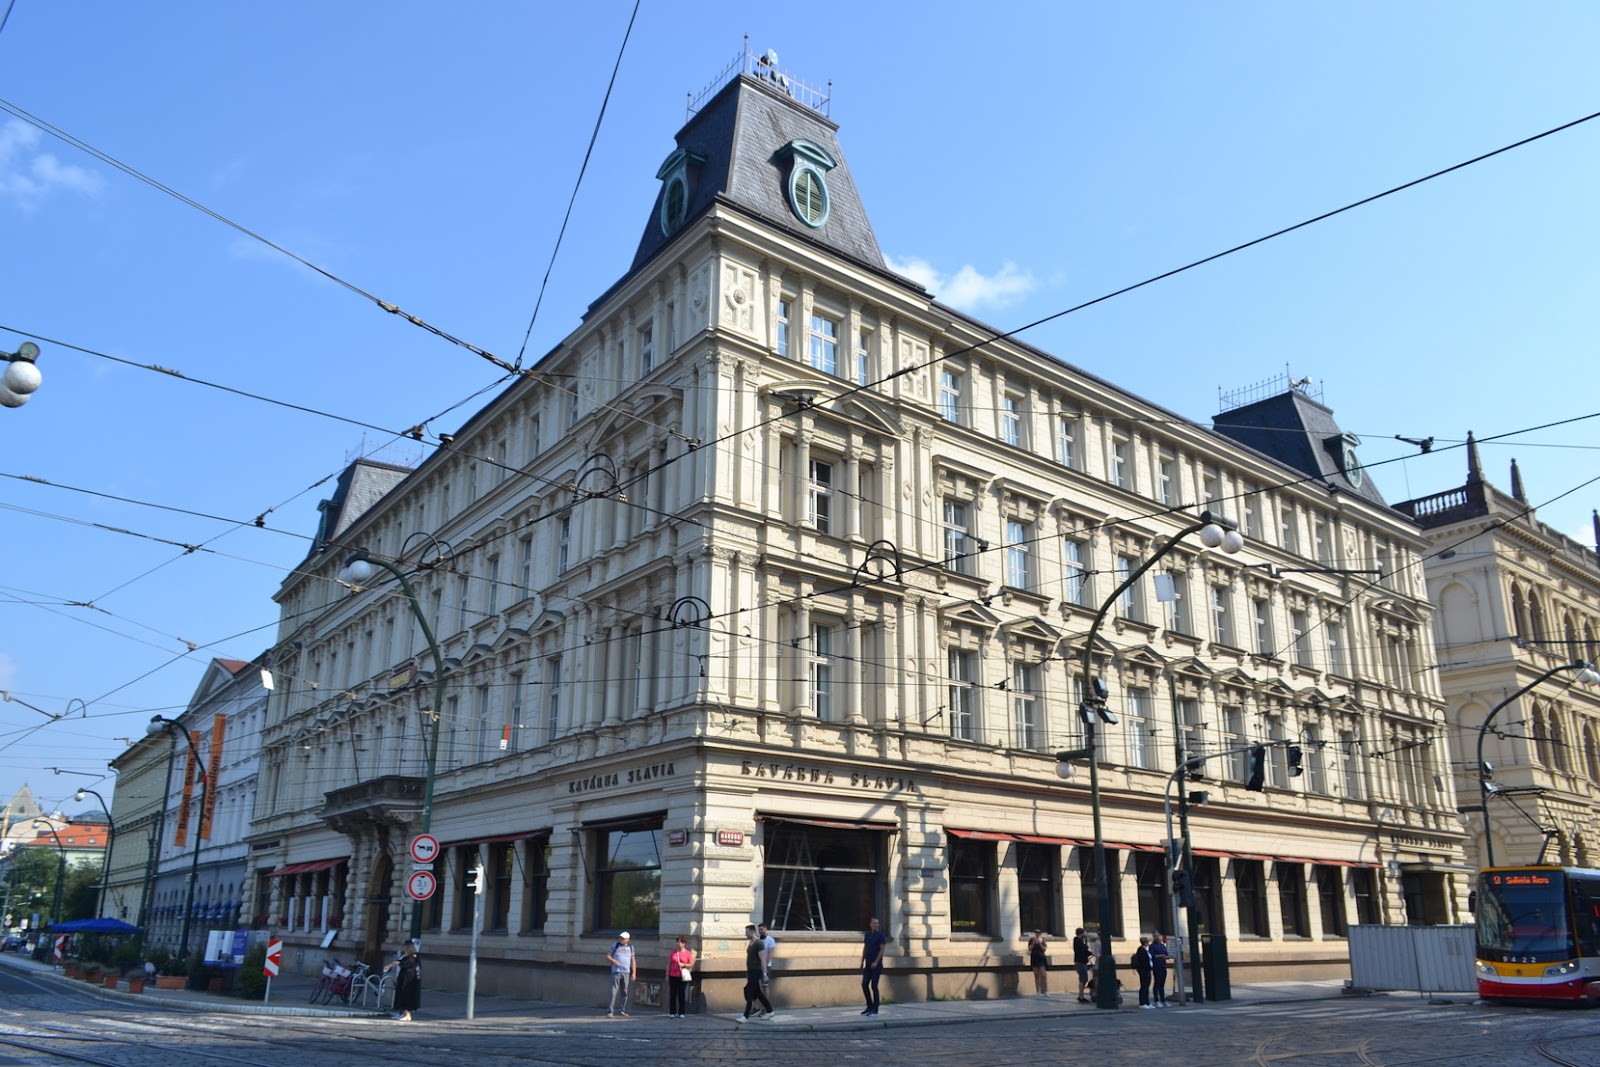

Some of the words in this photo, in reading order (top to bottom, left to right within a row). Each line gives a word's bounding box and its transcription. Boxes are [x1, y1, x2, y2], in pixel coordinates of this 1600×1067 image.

[569, 773, 619, 793] KAVÁRNA
[627, 763, 675, 783] SLAVIA
[741, 760, 834, 784] KAVÁRNA
[850, 773, 916, 793] SLAVIA
[179, 794, 191, 830] Bagnoli
